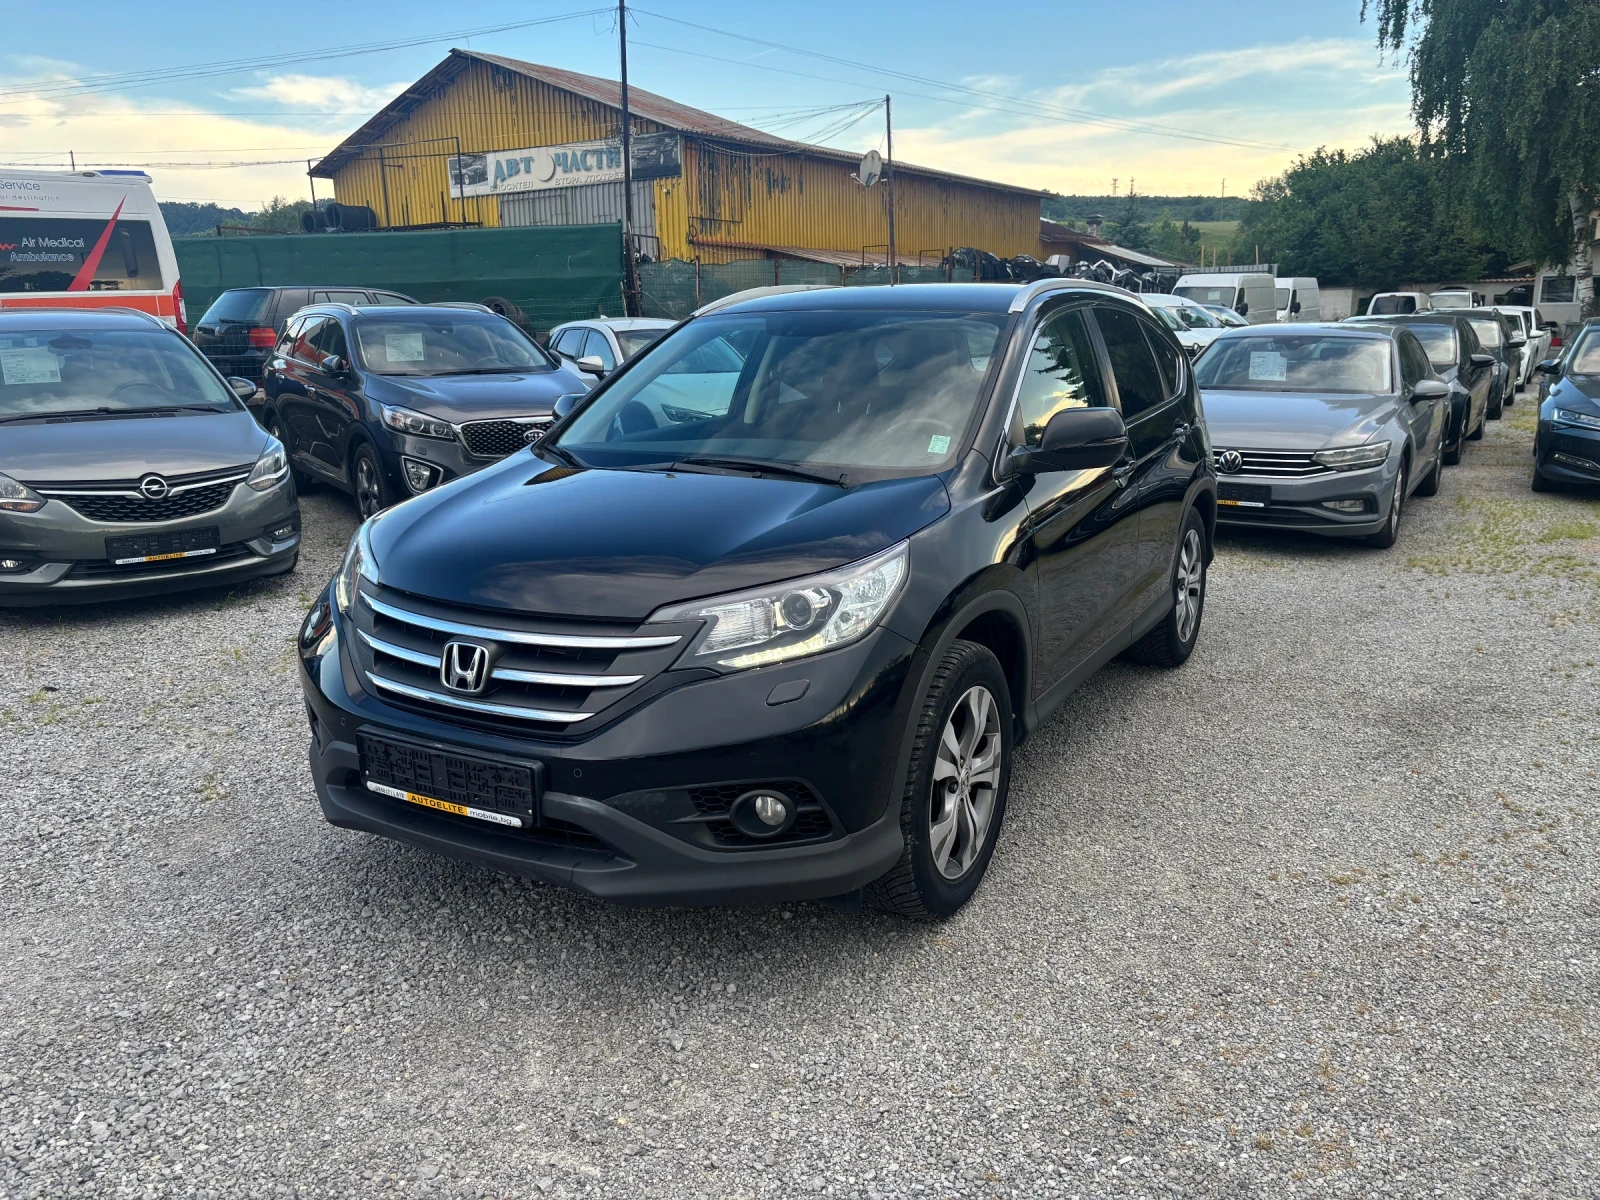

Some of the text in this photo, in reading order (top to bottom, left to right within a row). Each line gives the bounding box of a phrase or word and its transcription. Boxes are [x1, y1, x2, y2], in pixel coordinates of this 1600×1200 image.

[0, 180, 40, 191] Service
[555, 176, 582, 186] ВТОРА
[21, 237, 84, 248] Air Medical
[10, 251, 75, 262] Ambulance
[411, 793, 464, 815] AUTOELITE
